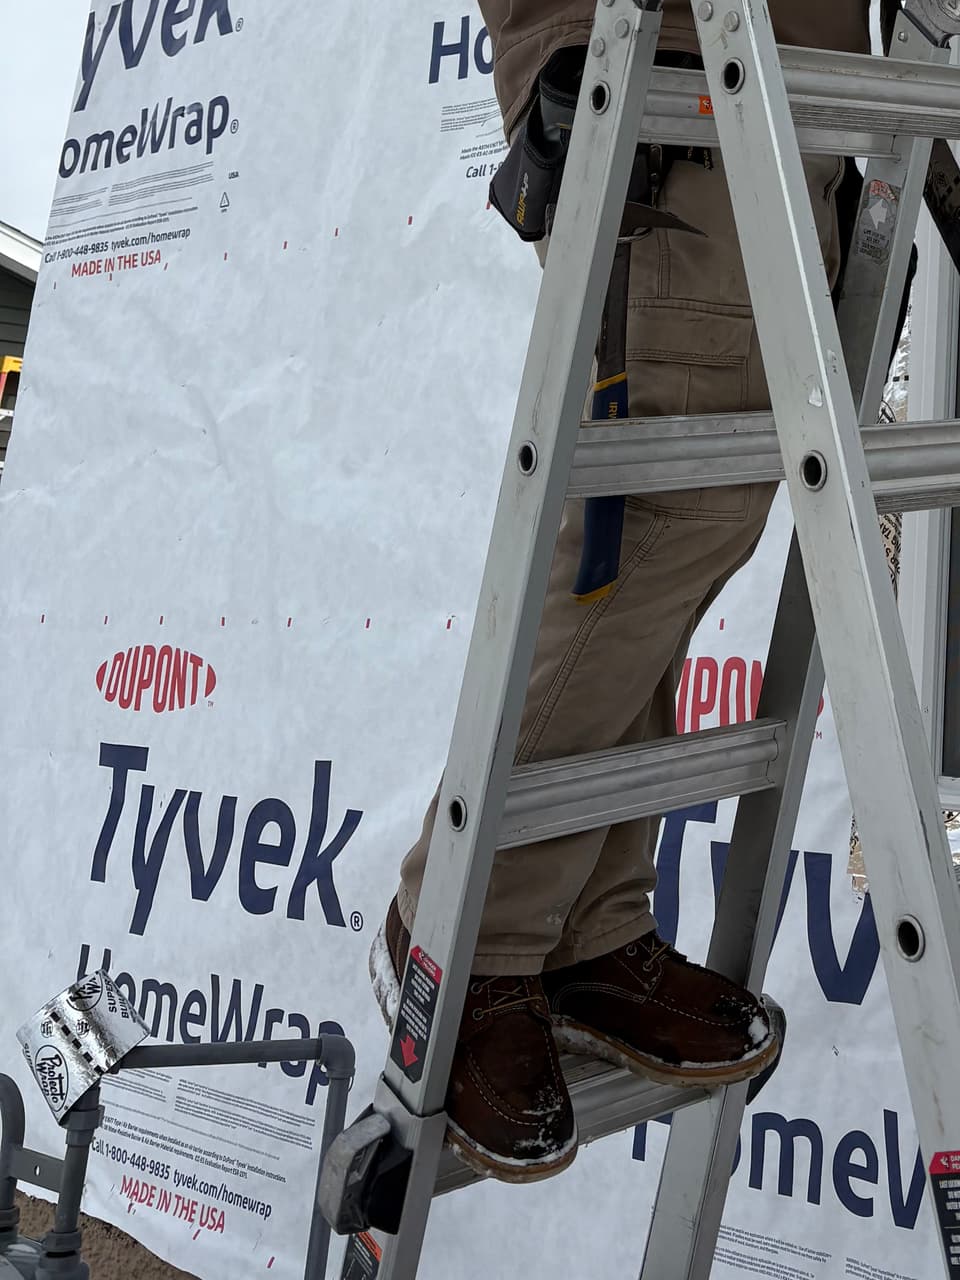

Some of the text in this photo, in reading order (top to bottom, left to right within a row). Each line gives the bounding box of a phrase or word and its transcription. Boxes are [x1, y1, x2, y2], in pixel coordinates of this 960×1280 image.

[466, 164, 486, 178] Call
[71, 249, 161, 278] MADE IN THE USA
[105, 644, 203, 713] DUPONT
[40, 1054, 65, 1104] Protecto
[106, 1143, 170, 1180] 1-800-448-9835
[173, 1168, 272, 1220] tyvek.com/homewrap
[120, 1175, 225, 1234] MADE IN THE USA
